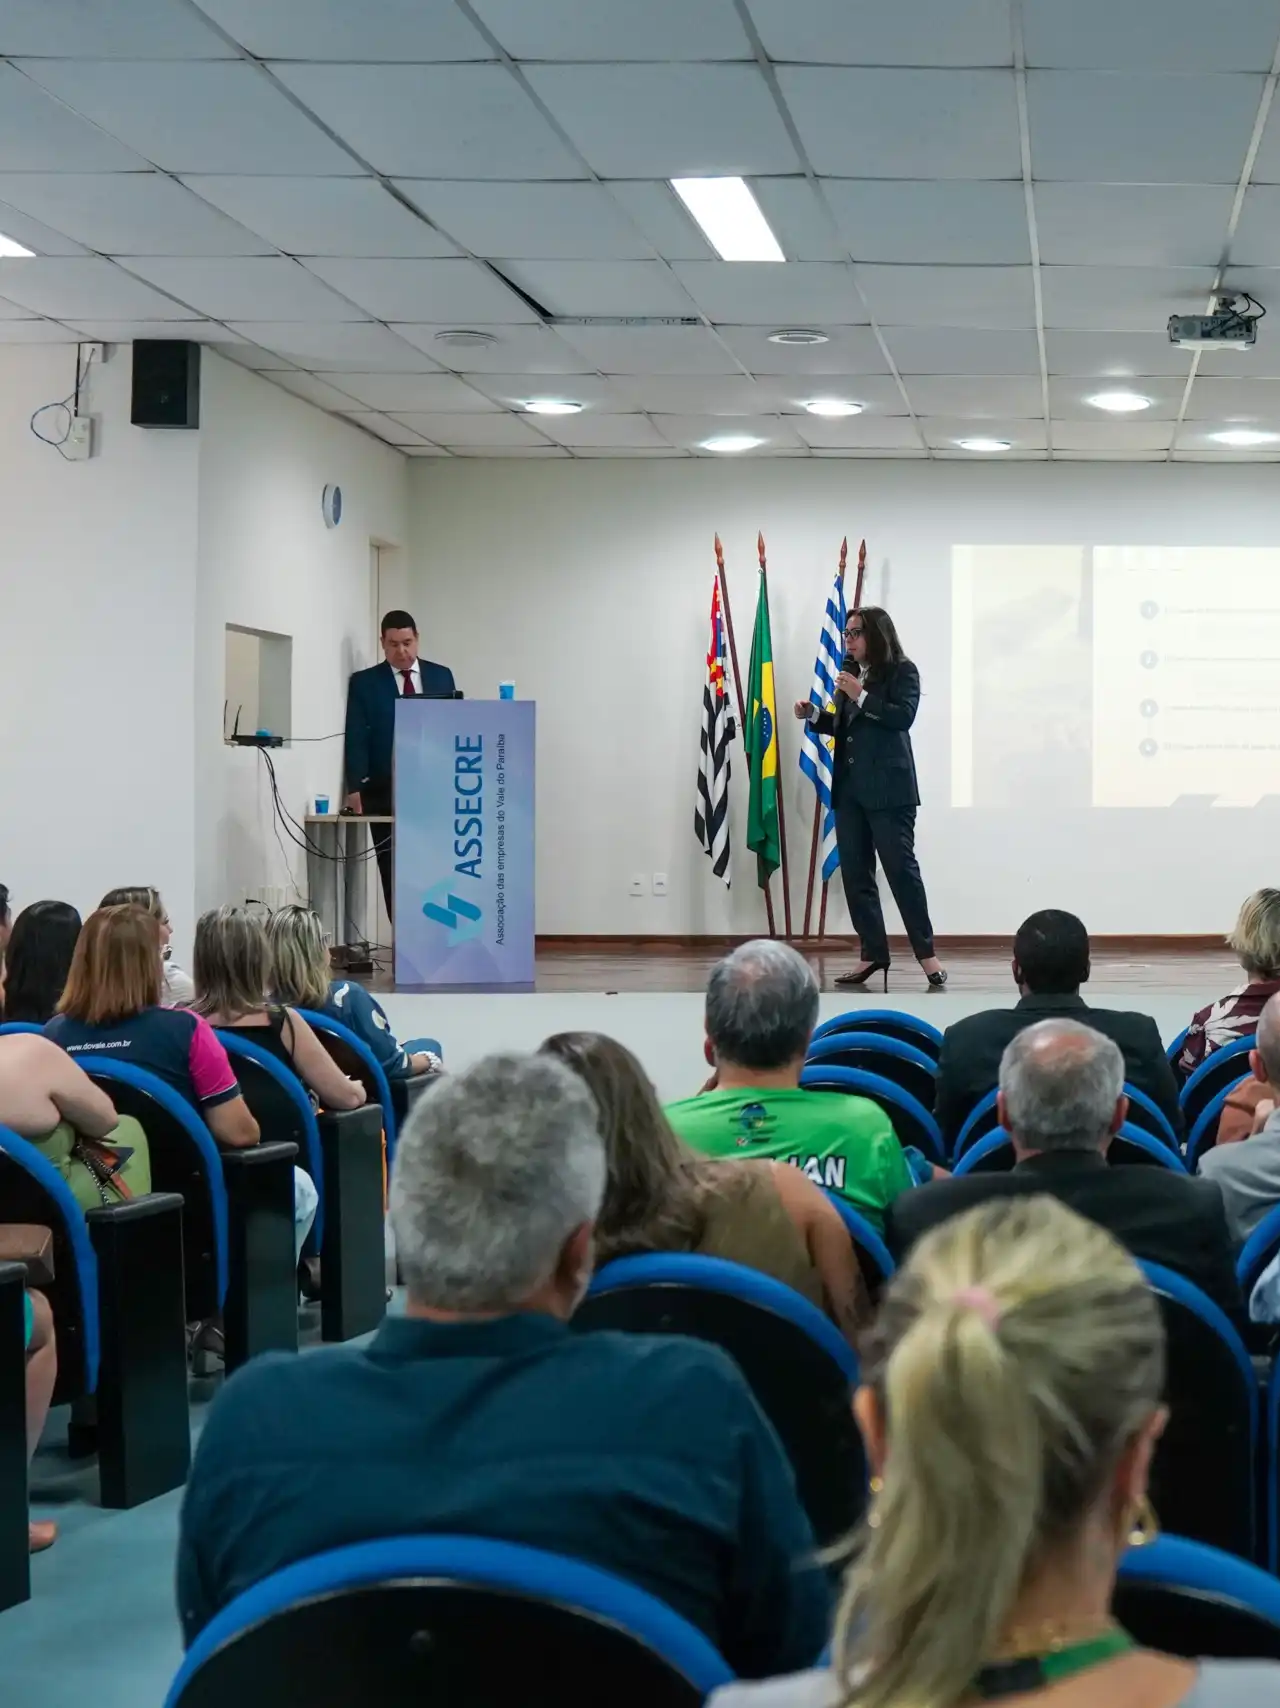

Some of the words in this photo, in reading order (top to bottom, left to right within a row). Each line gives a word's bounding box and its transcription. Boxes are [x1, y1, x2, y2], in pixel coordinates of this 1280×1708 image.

[496, 773, 505, 785] do
[454, 734, 482, 879] ASSECRE
[496, 788, 505, 808] Vale
[496, 810, 505, 822] do
[497, 824, 506, 870] empresas
[495, 873, 505, 890] das
[495, 892, 508, 945] Associação
